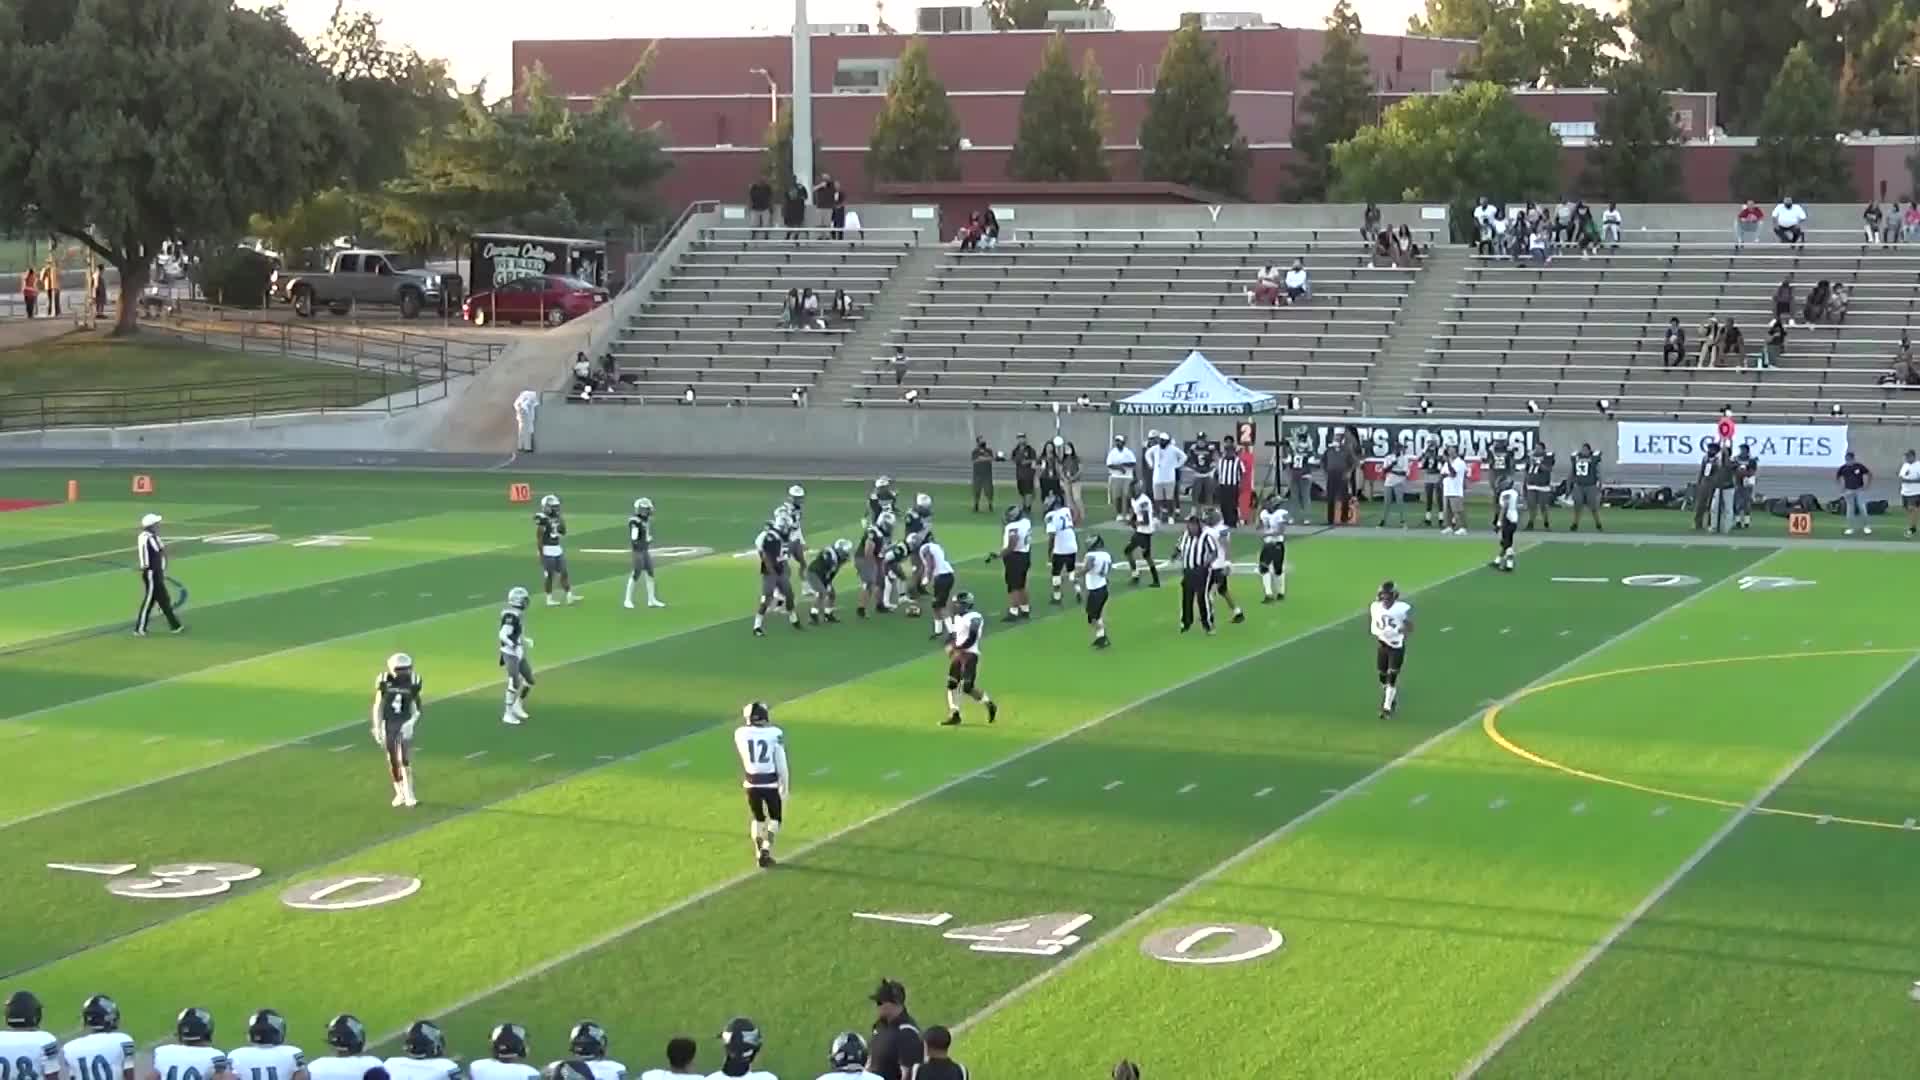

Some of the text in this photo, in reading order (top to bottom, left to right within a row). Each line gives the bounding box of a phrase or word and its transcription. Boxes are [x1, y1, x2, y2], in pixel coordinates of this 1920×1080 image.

[1119, 403, 1172, 415] PATRIOT
[1174, 403, 1245, 415] ATHLETICS
[1240, 423, 1252, 443] 2
[1317, 426, 1390, 457] LT'S
[1440, 429, 1534, 460] PATS!
[1633, 434, 1693, 455] LETS
[1744, 435, 1833, 457] PATES
[514, 485, 529, 499] 10
[1792, 515, 1808, 531] 40
[391, 693, 402, 714] 4
[747, 738, 771, 764] 12
